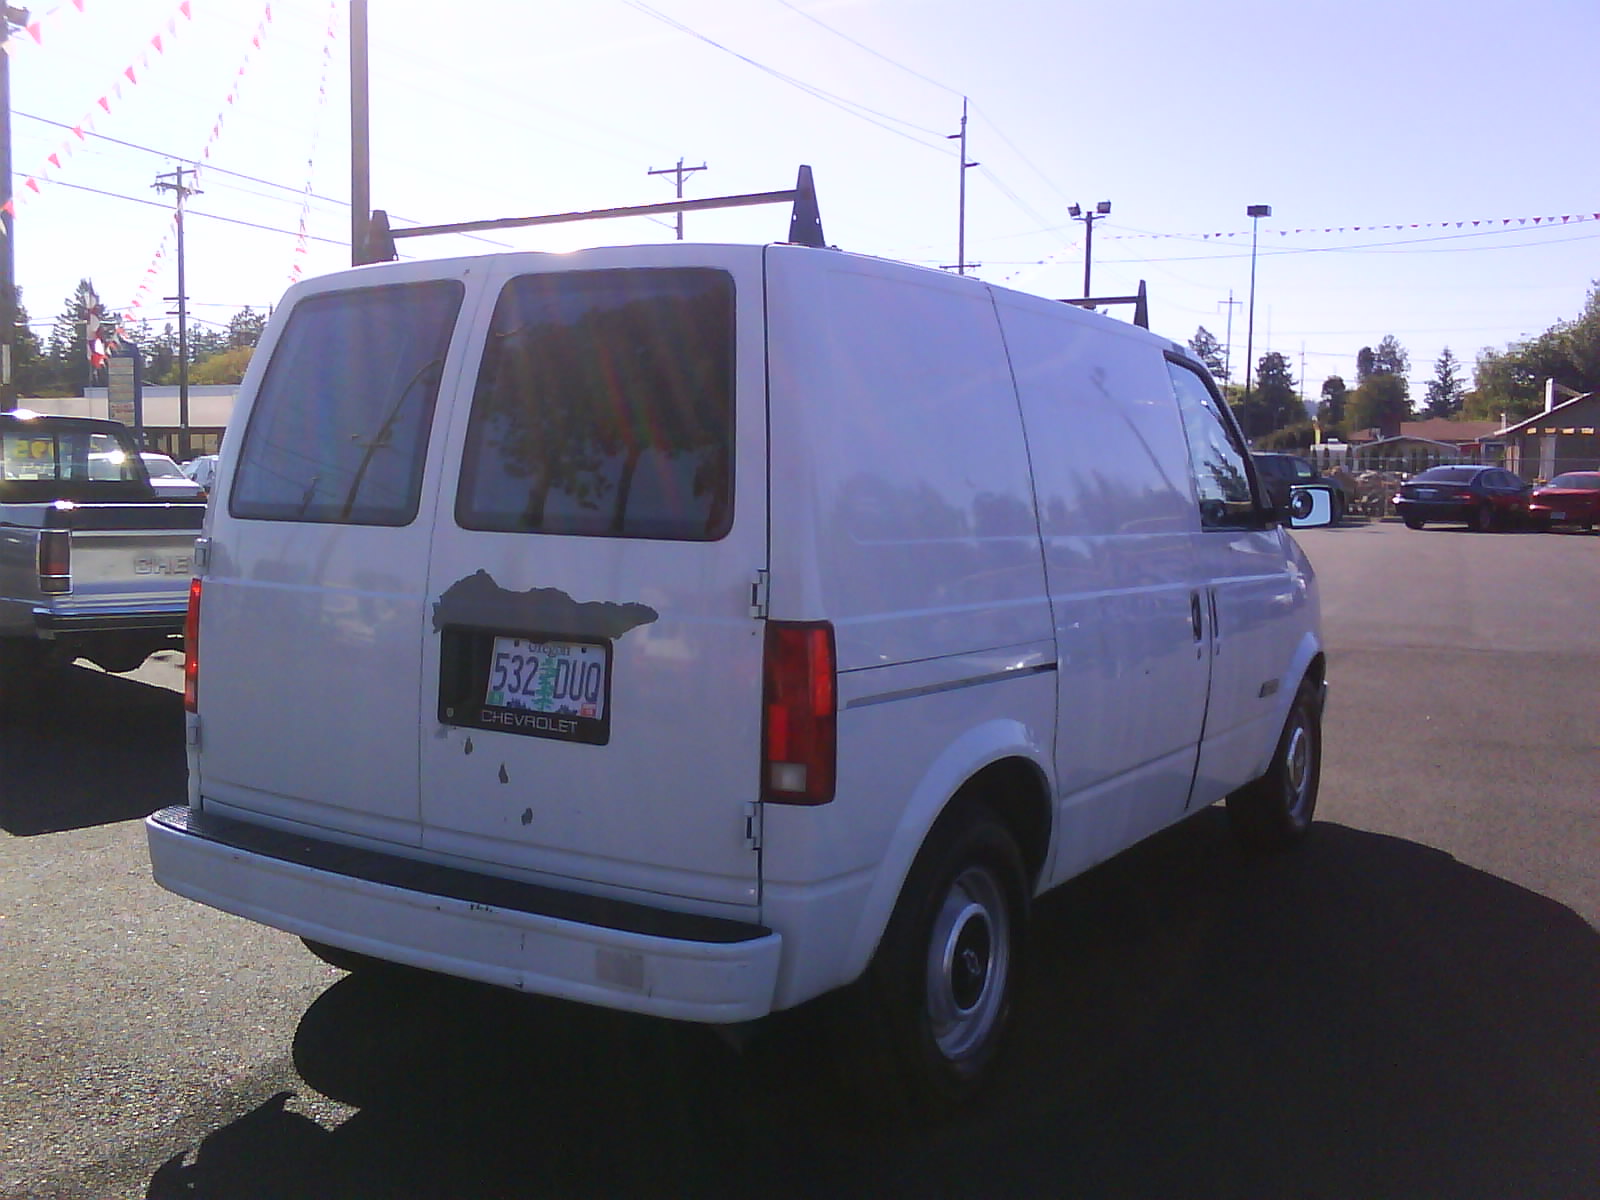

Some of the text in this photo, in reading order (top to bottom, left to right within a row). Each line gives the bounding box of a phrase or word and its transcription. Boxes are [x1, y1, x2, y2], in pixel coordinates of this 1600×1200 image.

[492, 653, 601, 703] 532 DUQ
[480, 710, 578, 734] CHEVROLET
